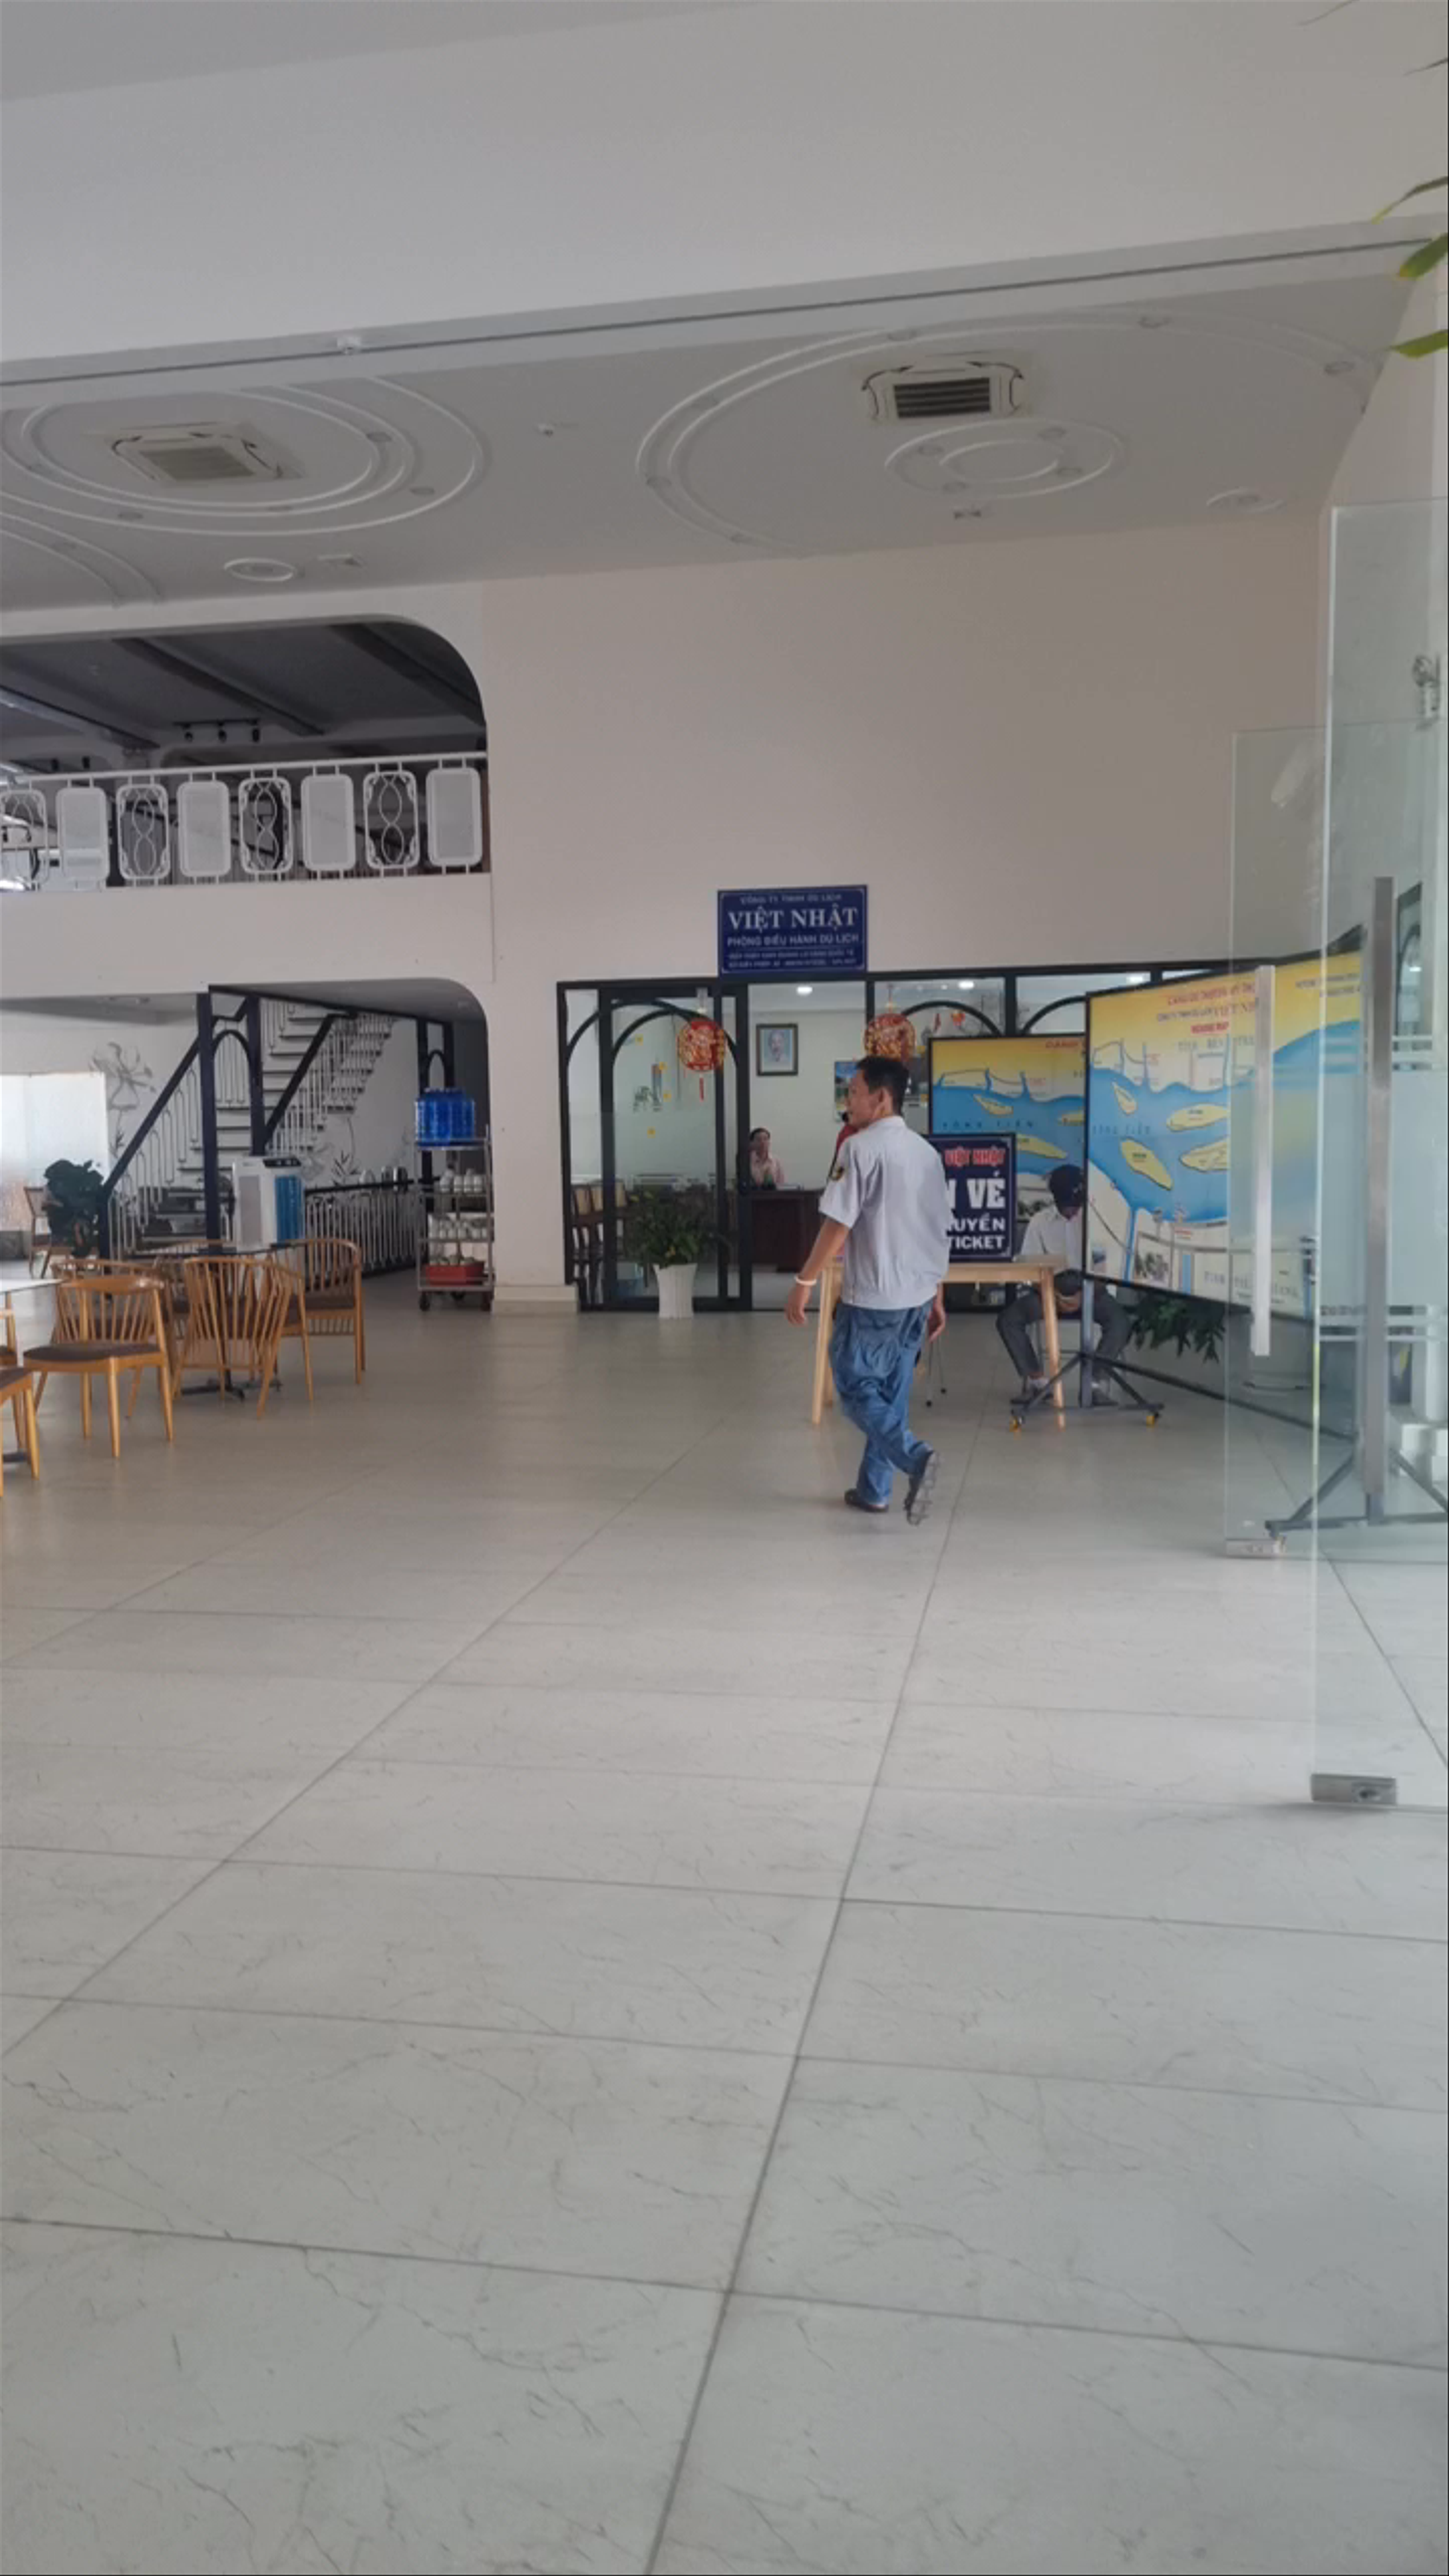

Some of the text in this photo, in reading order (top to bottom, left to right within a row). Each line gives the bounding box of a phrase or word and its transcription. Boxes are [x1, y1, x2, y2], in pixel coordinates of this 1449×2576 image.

[728, 903, 858, 933] VIỆT NHẬT
[945, 1144, 1006, 1167] VIỆT NHẬT
